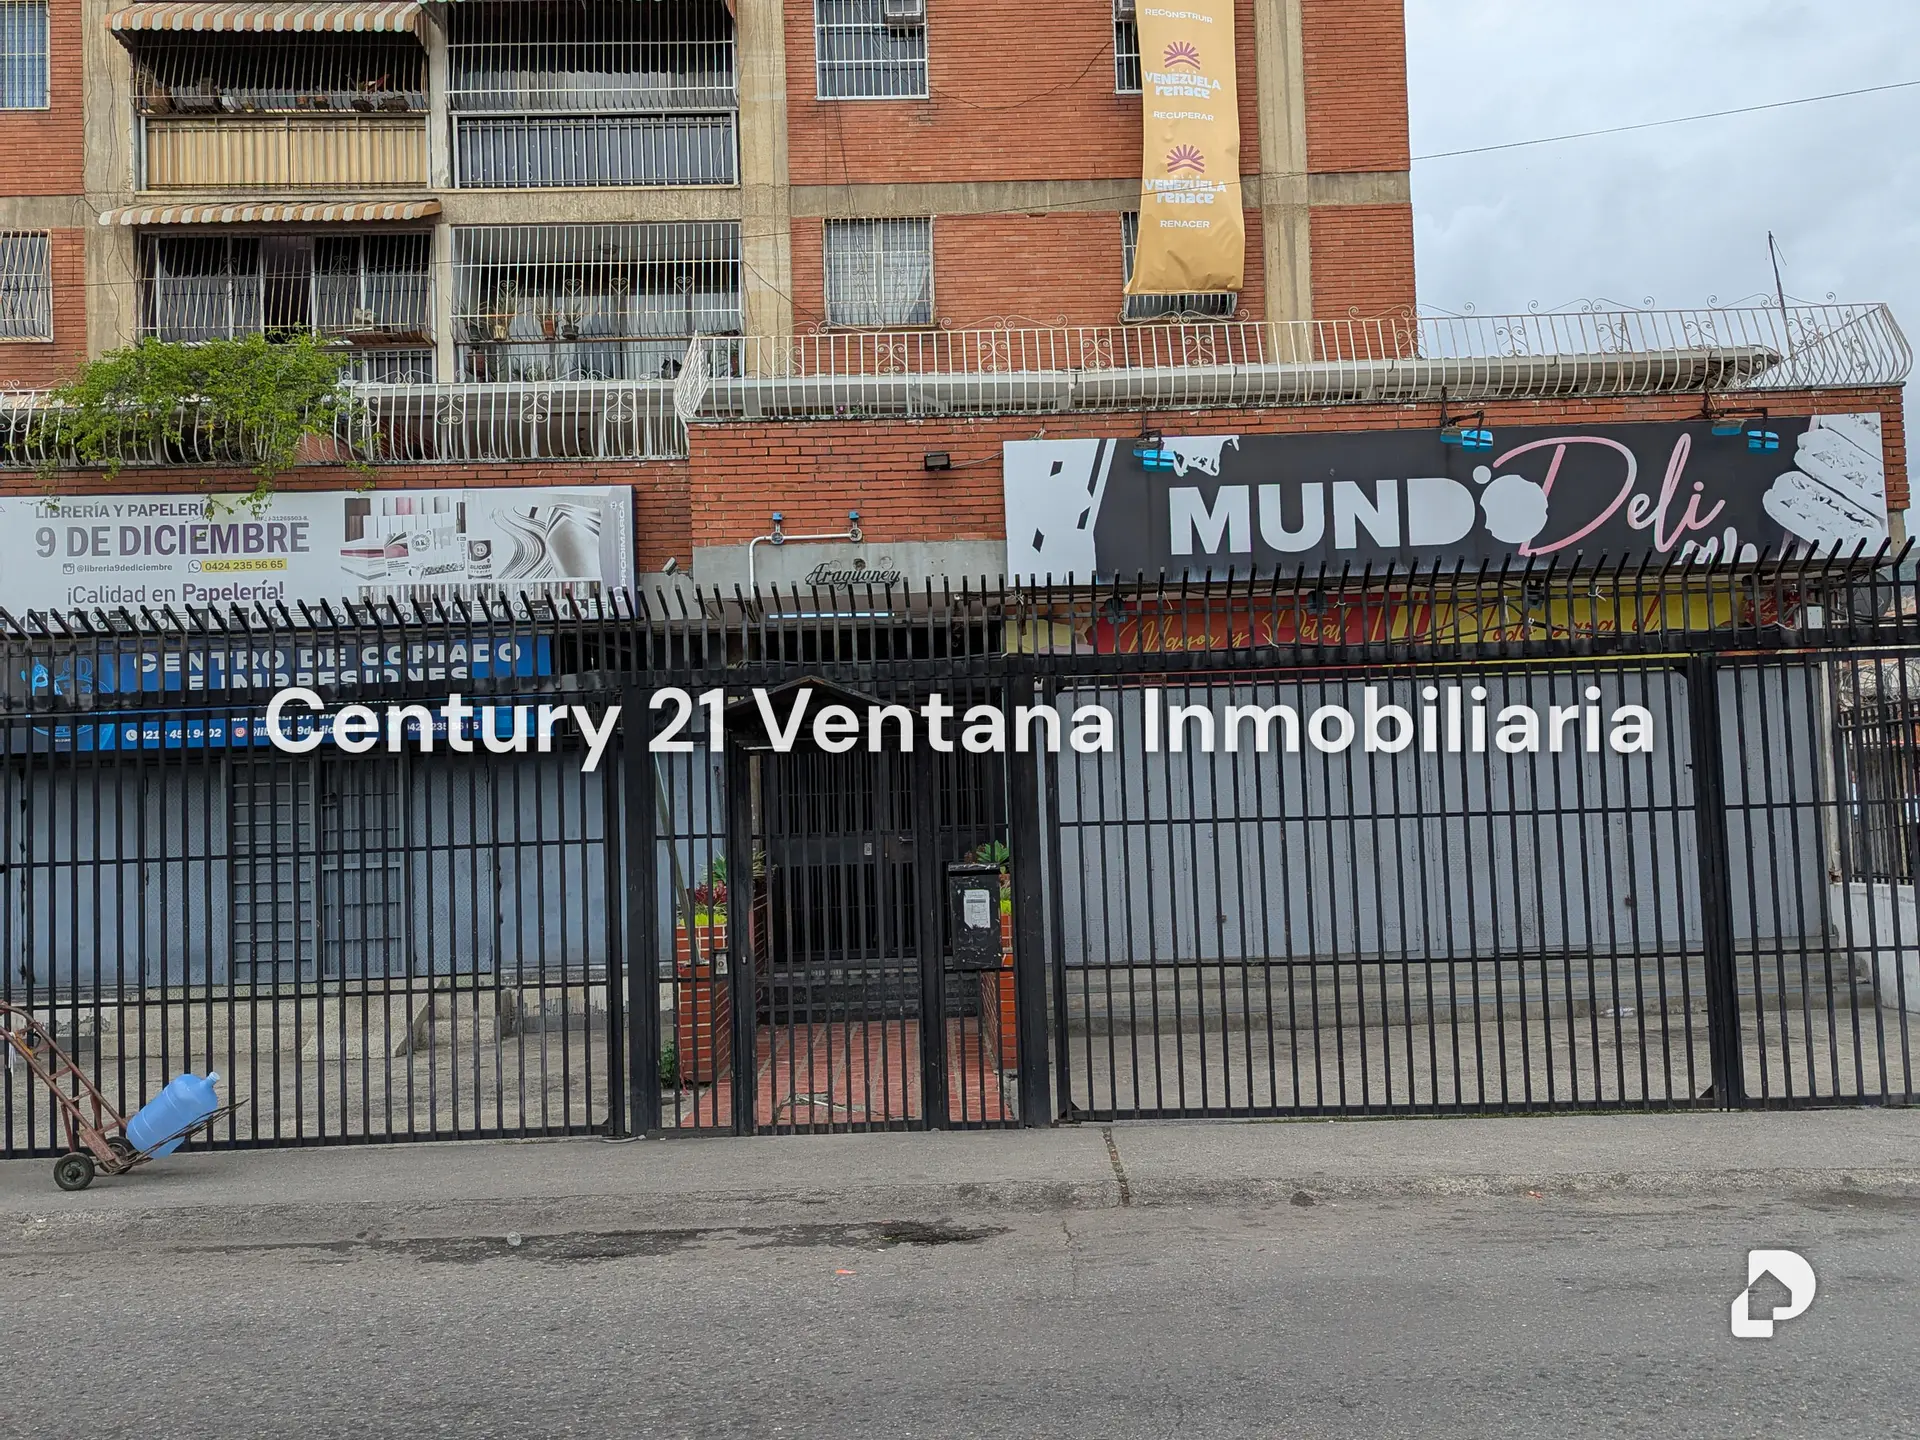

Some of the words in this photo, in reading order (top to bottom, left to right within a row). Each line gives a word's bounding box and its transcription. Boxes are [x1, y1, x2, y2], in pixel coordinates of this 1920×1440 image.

[1144, 8, 1213, 24] RECONSTRUIR
[1144, 70, 1221, 91] VENEZUELA
[1155, 85, 1210, 100] renace
[1153, 110, 1214, 122] RECUPERAR
[1144, 178, 1227, 193] VENEZUELA
[1156, 192, 1214, 204] renace
[1160, 220, 1210, 228] RENACER
[1168, 465, 1550, 556] MUNDO
[1492, 432, 1727, 558] Deli
[113, 504, 124, 518] Y
[35, 526, 56, 558] 9
[66, 526, 111, 557] DE
[119, 522, 310, 556] DICIEMBRE
[619, 501, 627, 587] PRODIMARCA
[77, 563, 173, 573] @libreria9dediciembre
[205, 561, 231, 571] 0424
[233, 560, 253, 570] 235
[255, 560, 268, 570] 56
[270, 560, 283, 569] 65
[805, 562, 901, 591] Araguaney
[67, 584, 146, 605] ¡Calidad
[152, 588, 176, 602] en
[182, 579, 284, 602] Papelería!
[133, 650, 285, 673] CENTRO
[300, 648, 347, 668] DE
[361, 642, 521, 666] COPIADO
